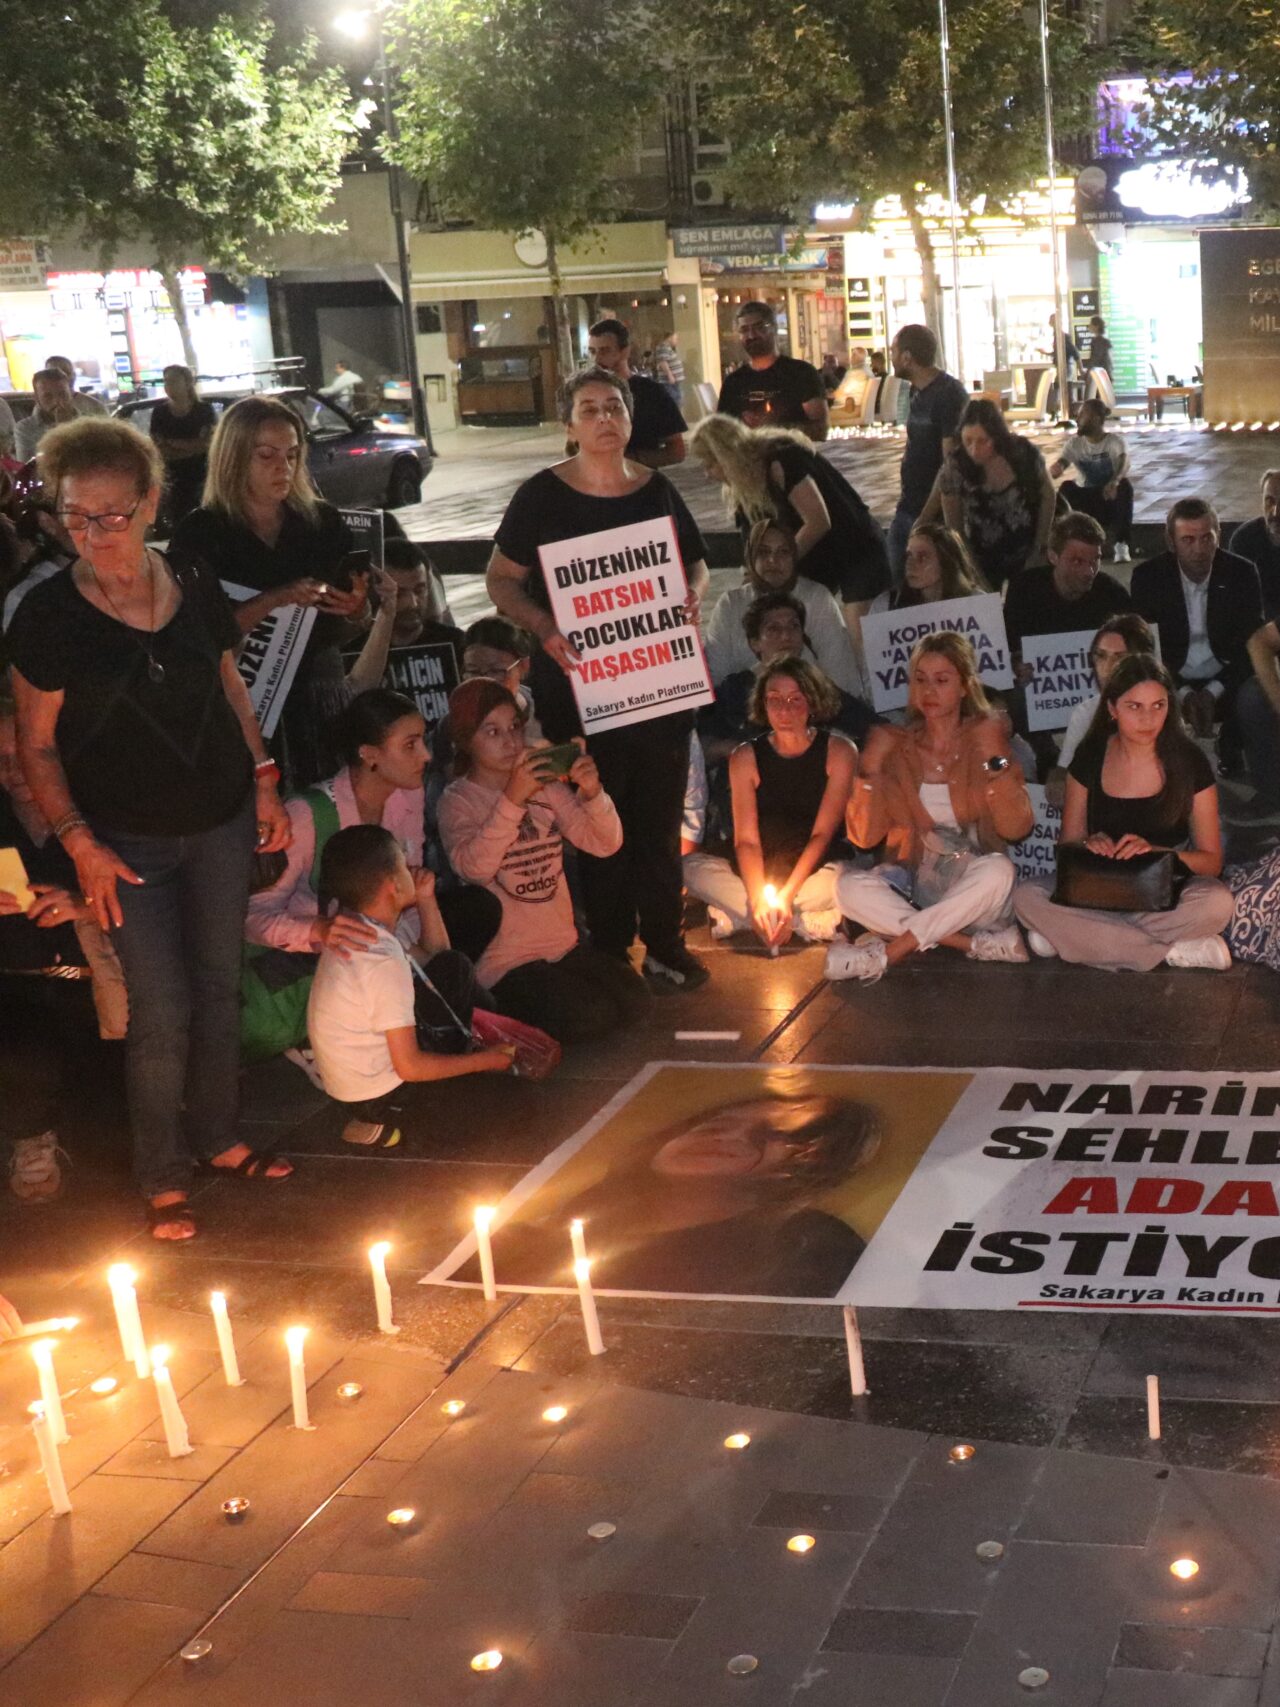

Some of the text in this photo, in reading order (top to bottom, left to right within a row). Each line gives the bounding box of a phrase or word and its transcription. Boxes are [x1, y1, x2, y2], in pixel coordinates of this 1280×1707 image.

[342, 514, 371, 527] ARİN
[554, 541, 672, 589] DÜZENİNİZ
[573, 576, 669, 619] BATSIN !
[575, 636, 696, 685] YAŞASIN!!!
[1035, 647, 1095, 673] KATİL
[1031, 672, 1095, 695] TANIY
[585, 679, 705, 717] Sakarya Kadın Platformu
[515, 875, 558, 895] addas
[1039, 1283, 1166, 1306] Sakarya
[1177, 1287, 1264, 1304] Kadın
